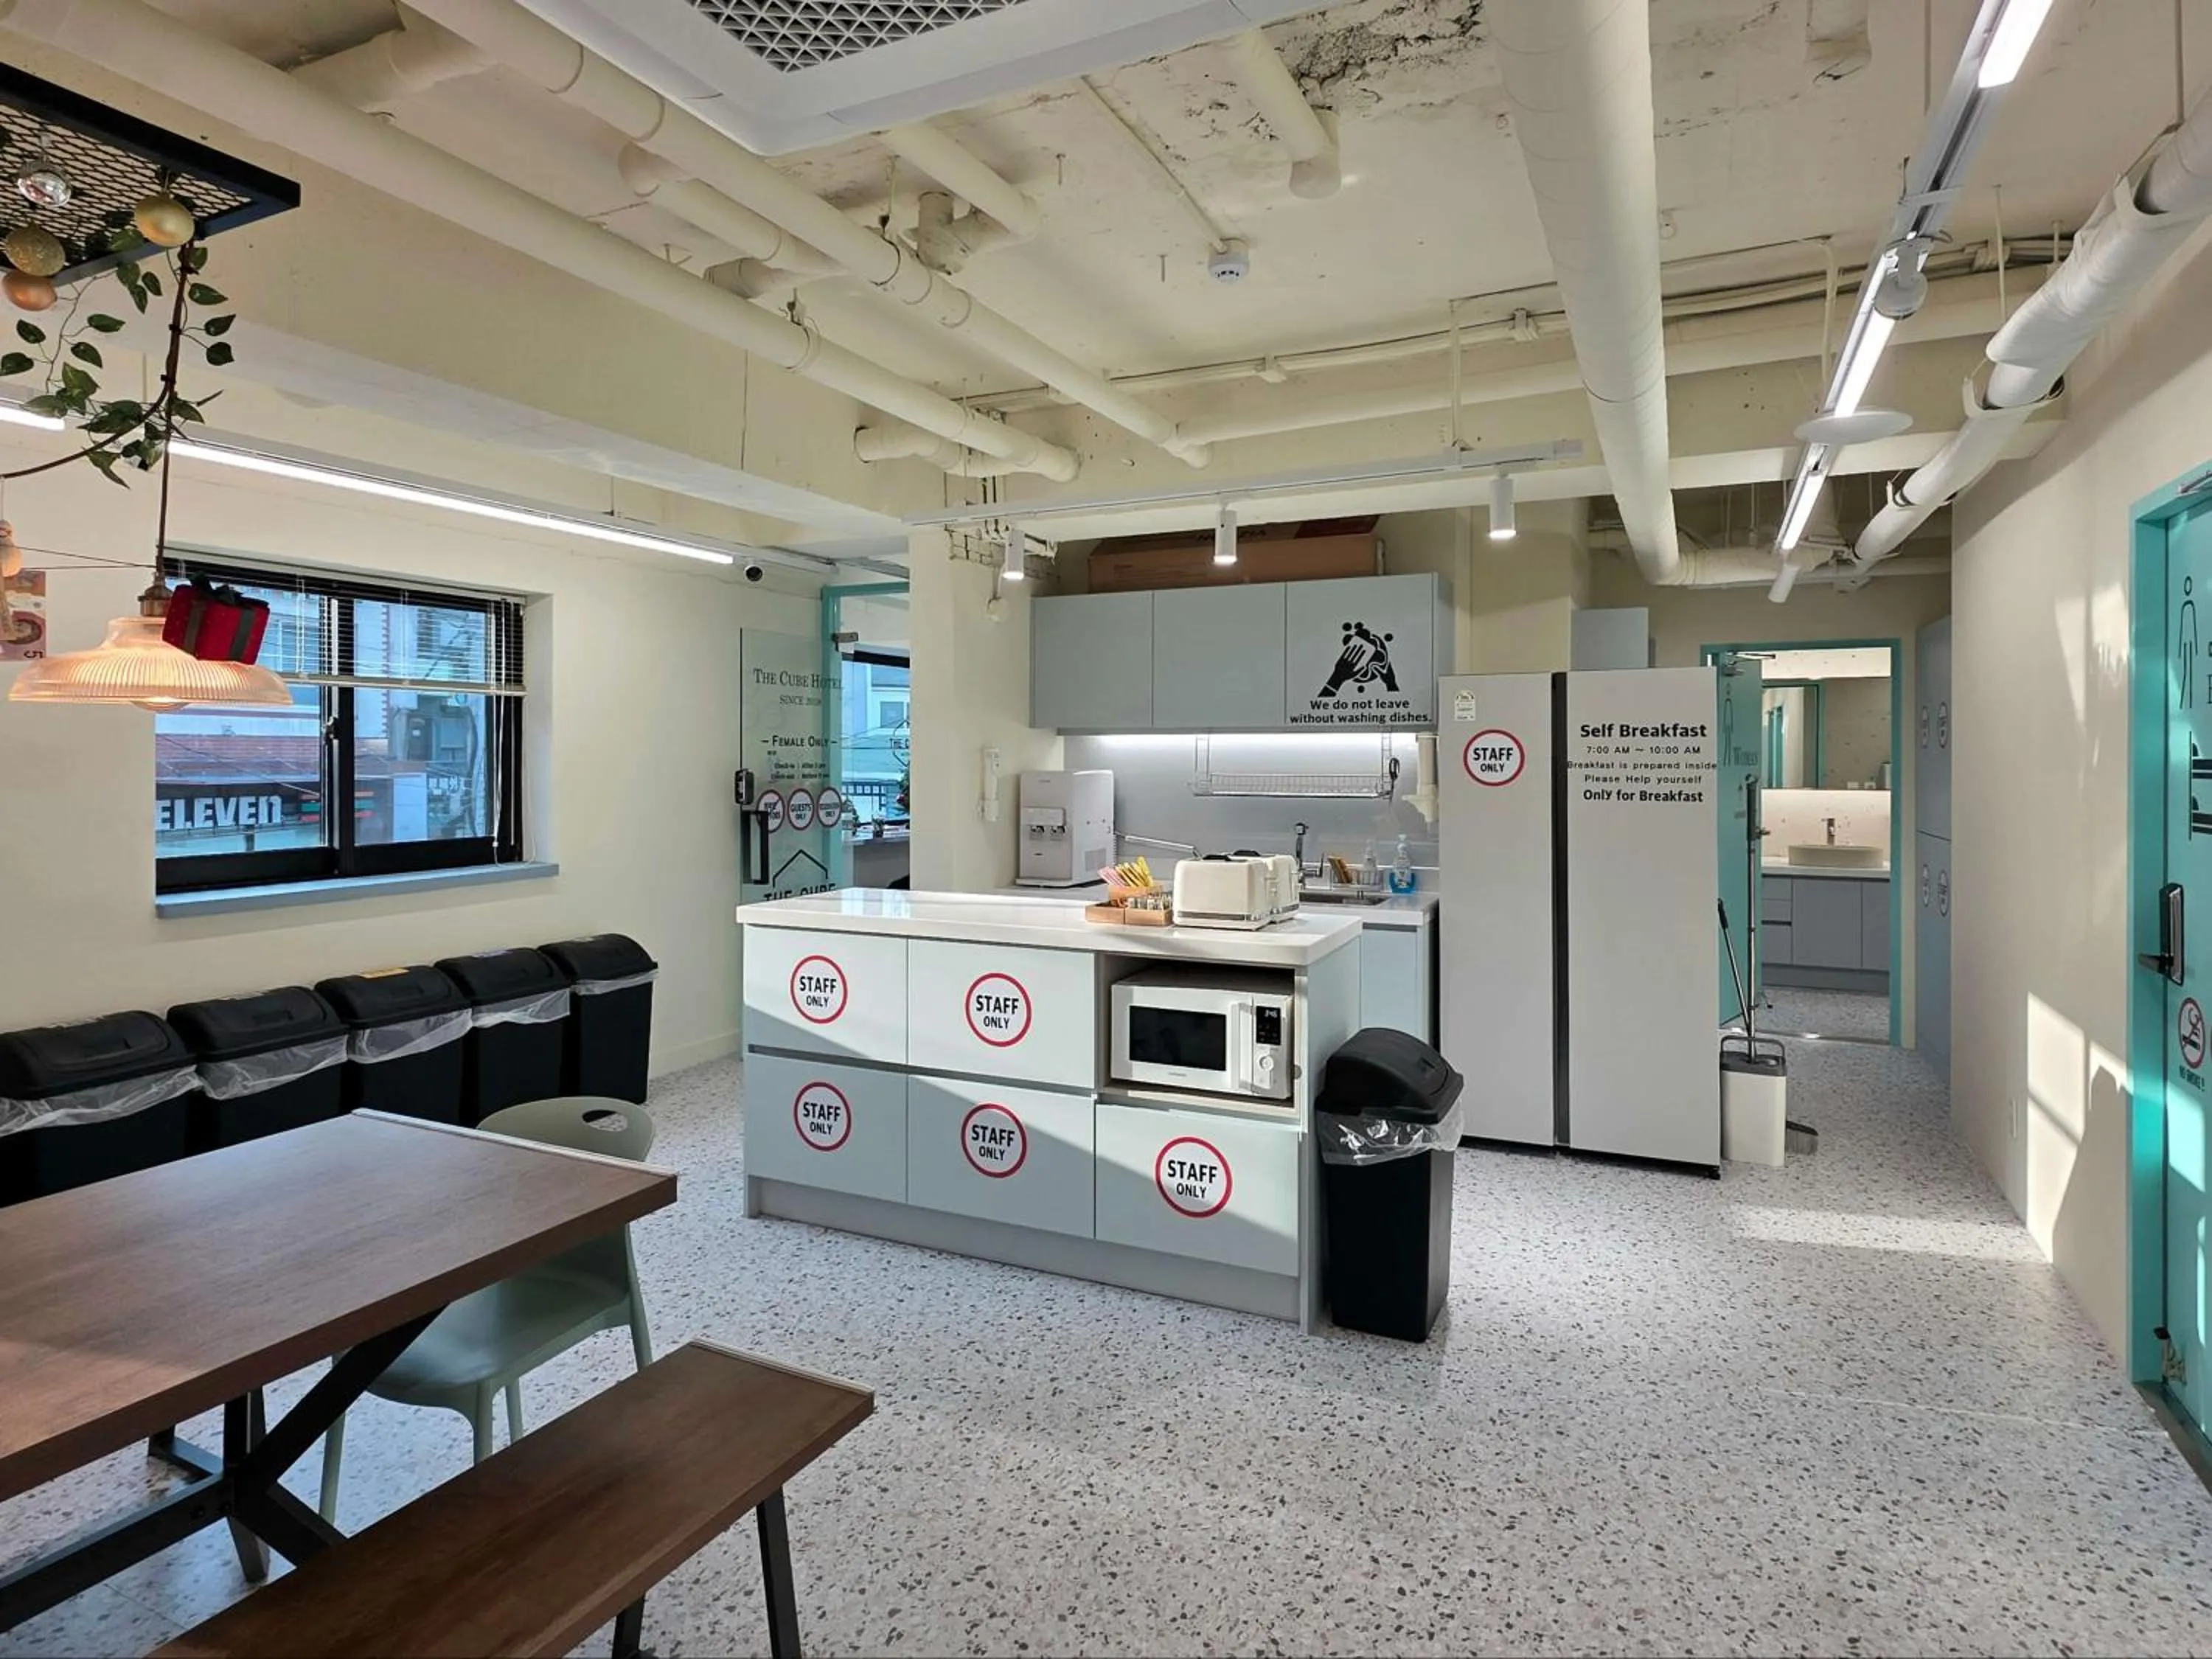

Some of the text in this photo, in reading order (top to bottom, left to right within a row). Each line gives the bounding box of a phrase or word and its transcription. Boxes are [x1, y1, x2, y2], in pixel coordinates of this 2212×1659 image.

[754, 668, 776, 684] THE
[779, 671, 808, 687] CUBE
[1310, 699, 1410, 710] We do not leave
[1290, 712, 1432, 723] without washing dishes.
[1580, 723, 1707, 737] Self Breakfast
[772, 735, 804, 746] FEMALE
[1473, 747, 1513, 761] STAFF
[1649, 746, 1678, 754] 10:00
[1481, 763, 1504, 773] ONLY
[1568, 760, 1614, 769] Breakfast
[1619, 761, 1627, 769] is
[1633, 761, 1680, 770] prepared
[1585, 774, 1702, 785] Please Help yourself
[1583, 789, 1703, 802] Only for Breakfast
[799, 975, 837, 994] STAFF
[806, 995, 830, 1007] ONLY
[975, 995, 1019, 1015] STAFF
[983, 1015, 1009, 1029] ONLY
[803, 1102, 841, 1121] STAFF
[810, 1121, 832, 1135] ONLY
[971, 1124, 1015, 1147] STAFF
[979, 1146, 1005, 1161] ONLY
[1167, 1160, 1217, 1183] STAFF
[1176, 1183, 1206, 1198] ONLY
